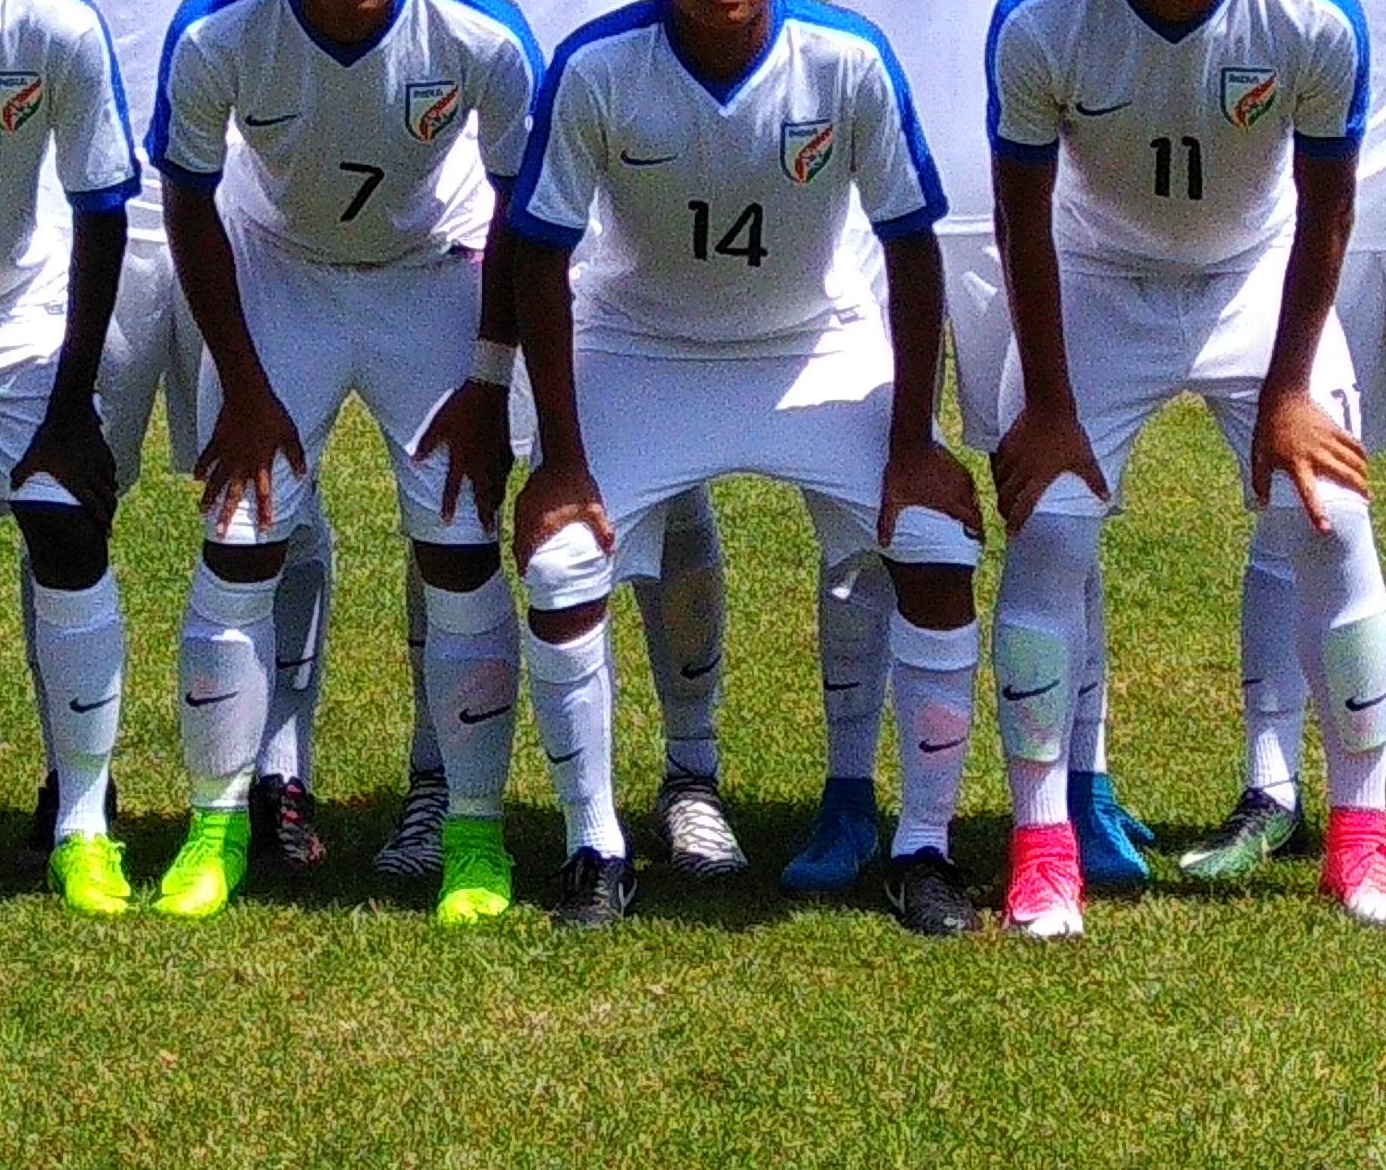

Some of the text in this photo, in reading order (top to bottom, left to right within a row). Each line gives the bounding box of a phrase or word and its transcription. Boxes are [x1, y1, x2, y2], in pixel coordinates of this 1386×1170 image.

[340, 161, 385, 223] 7
[1150, 136, 1203, 200] 11
[688, 200, 768, 267] 14
